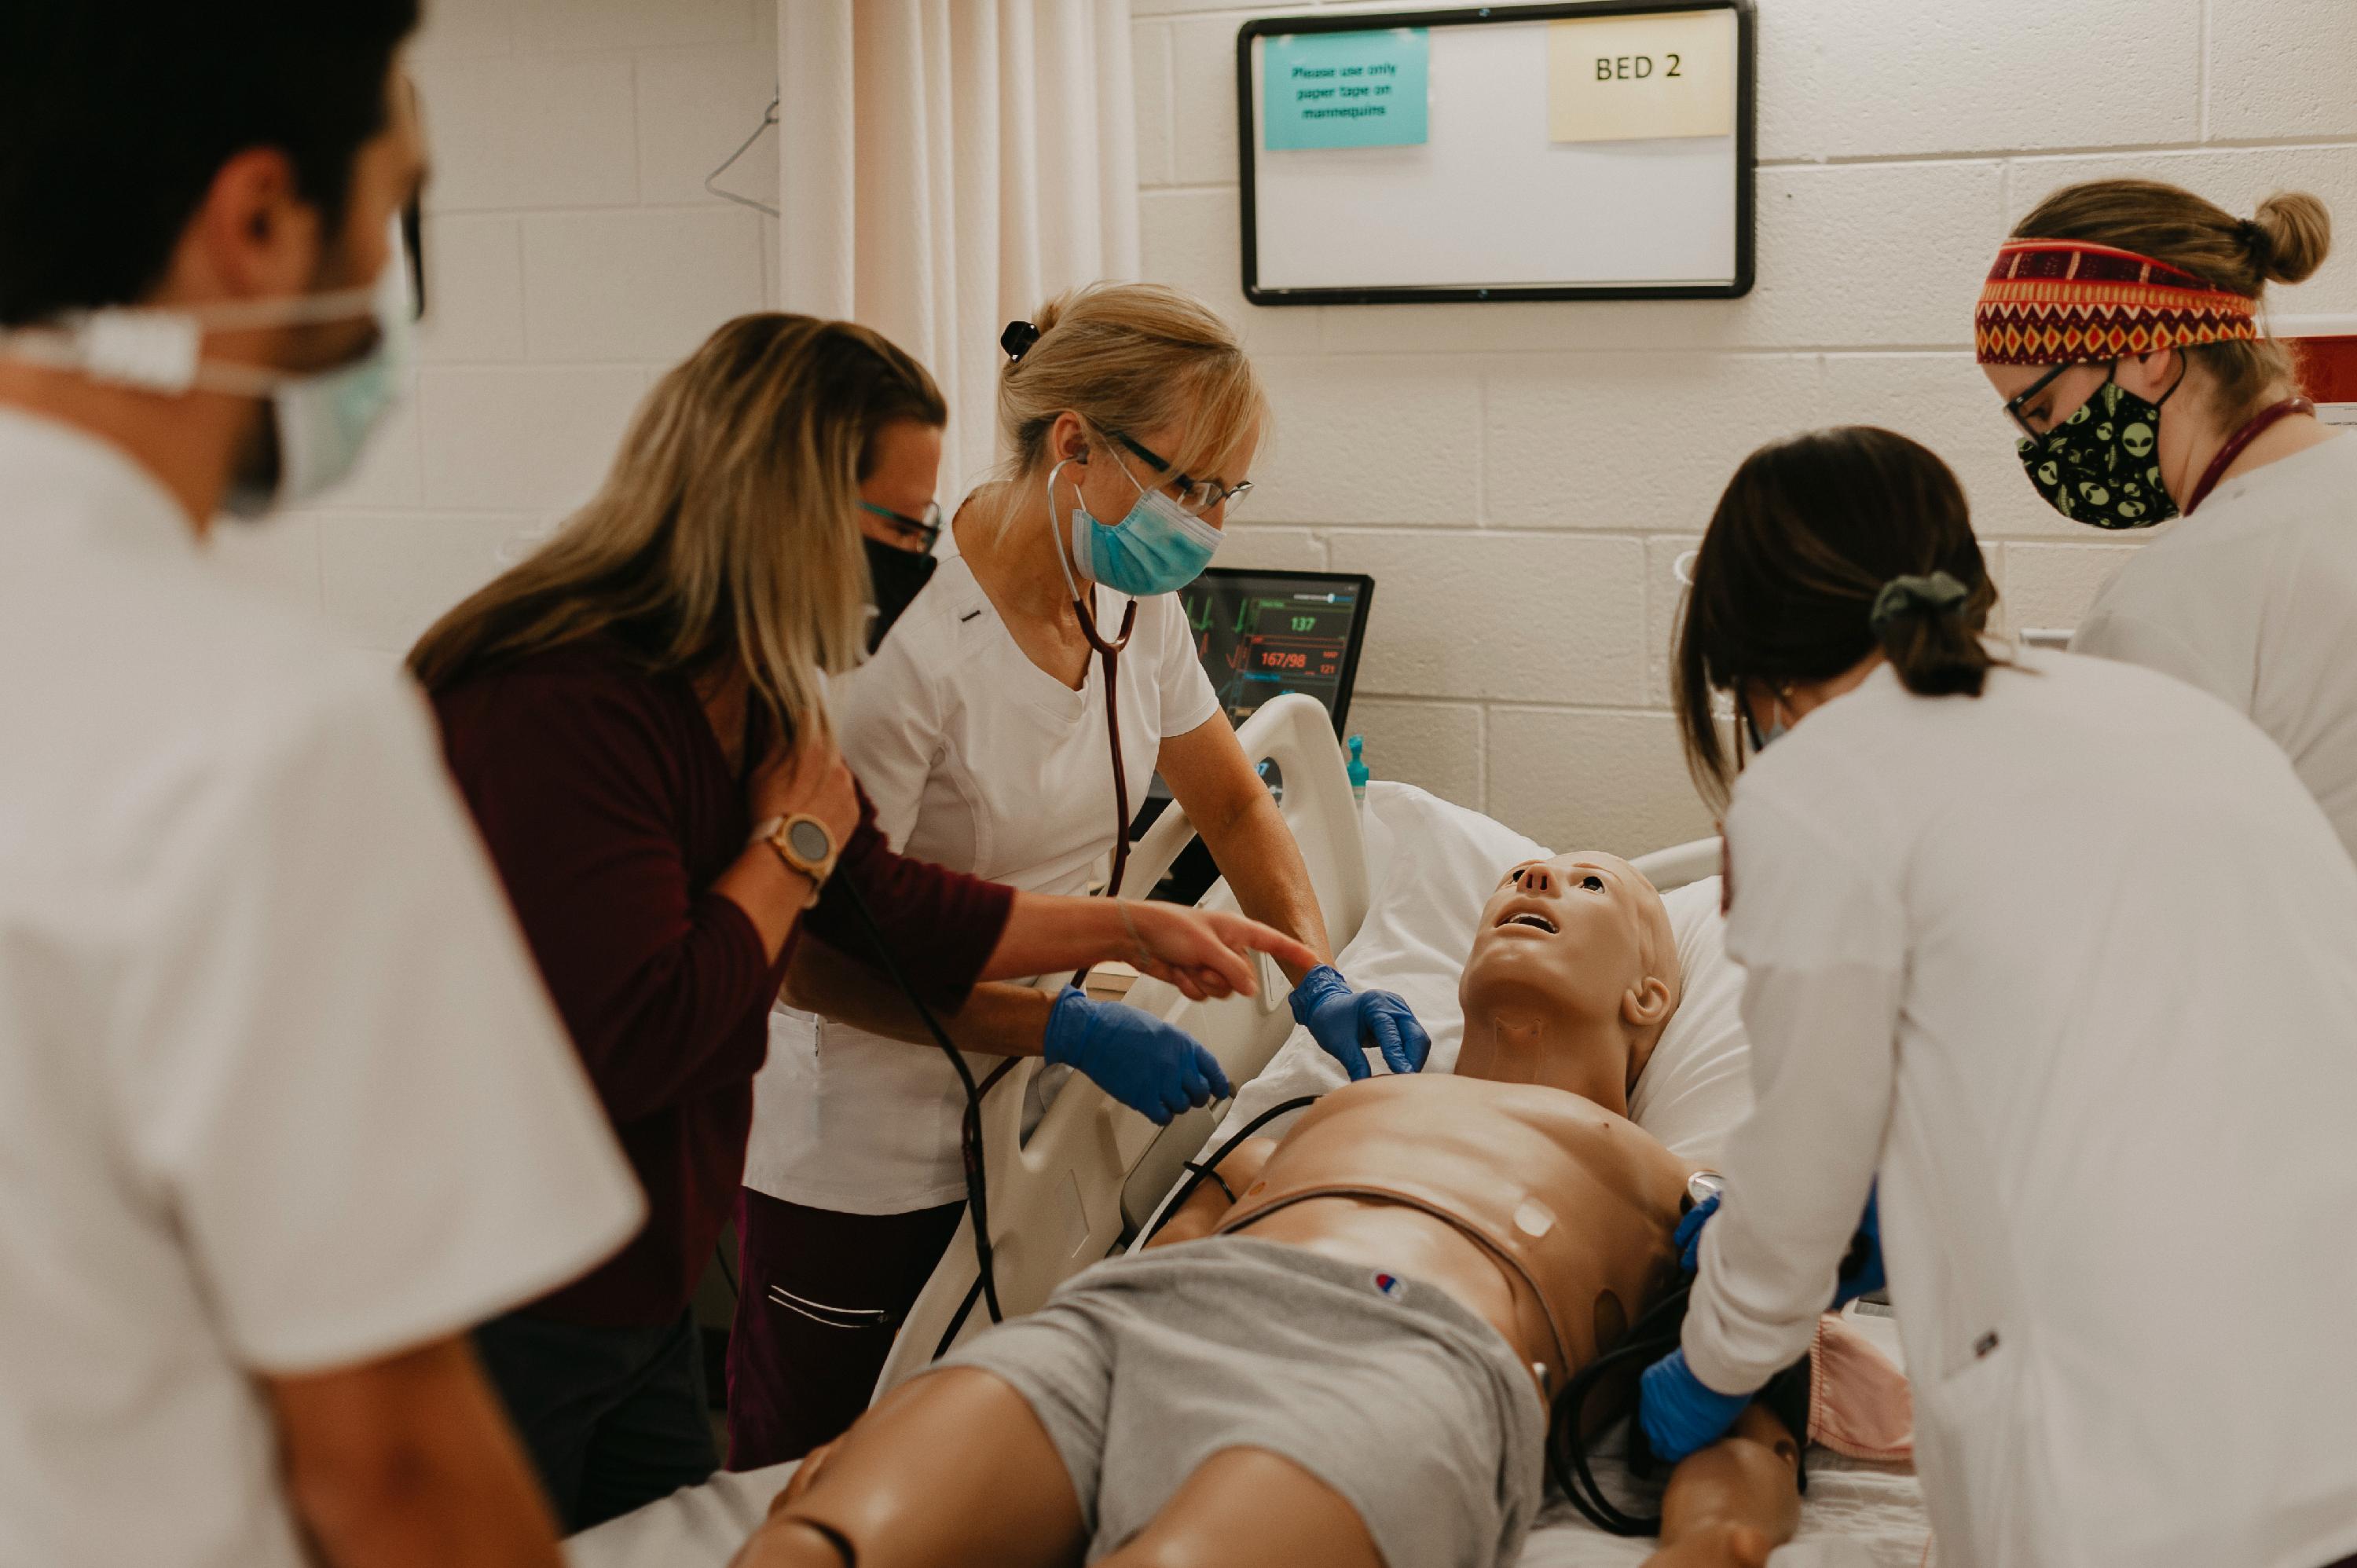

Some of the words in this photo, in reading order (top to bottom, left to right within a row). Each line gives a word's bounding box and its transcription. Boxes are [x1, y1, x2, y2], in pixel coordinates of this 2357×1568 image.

[1292, 66, 1335, 78] Please
[1340, 66, 1363, 76] use
[1369, 63, 1396, 76] only
[1596, 56, 1653, 81] BED
[1666, 53, 1681, 77] 2
[1298, 88, 1335, 101] paper
[1340, 86, 1369, 97] tape
[1374, 84, 1392, 95] on
[1303, 106, 1386, 119] mannequins
[1291, 617, 1317, 632] 137
[1262, 652, 1307, 668] 167/98
